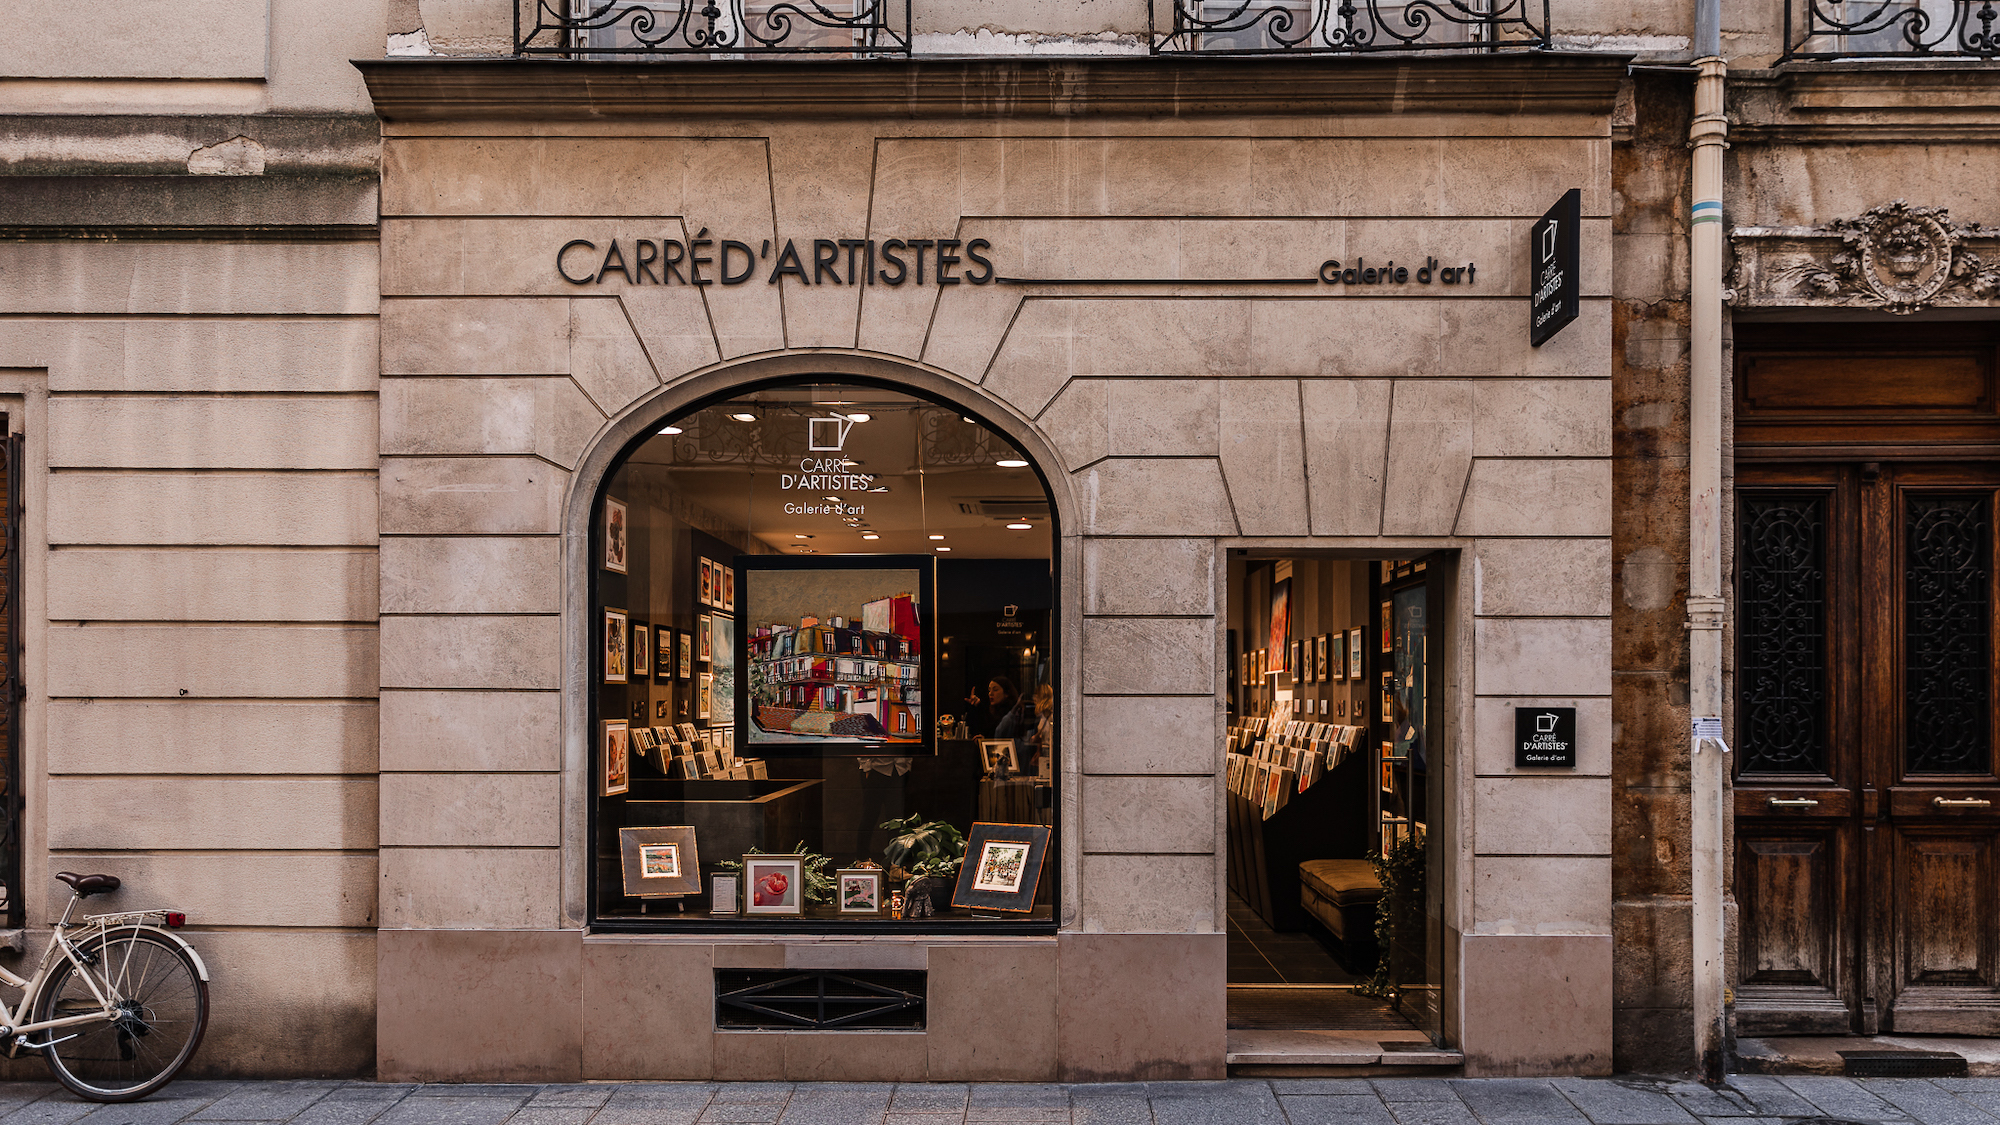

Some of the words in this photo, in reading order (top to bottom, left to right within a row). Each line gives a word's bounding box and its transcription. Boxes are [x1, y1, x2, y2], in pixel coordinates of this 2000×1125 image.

[1319, 258, 1409, 285] Galerie
[1416, 256, 1476, 284] d'art
[1536, 309, 1551, 328] Galerie
[800, 454, 850, 473] CARRÉ
[784, 502, 830, 515] Galerie
[834, 503, 865, 515] d'art
